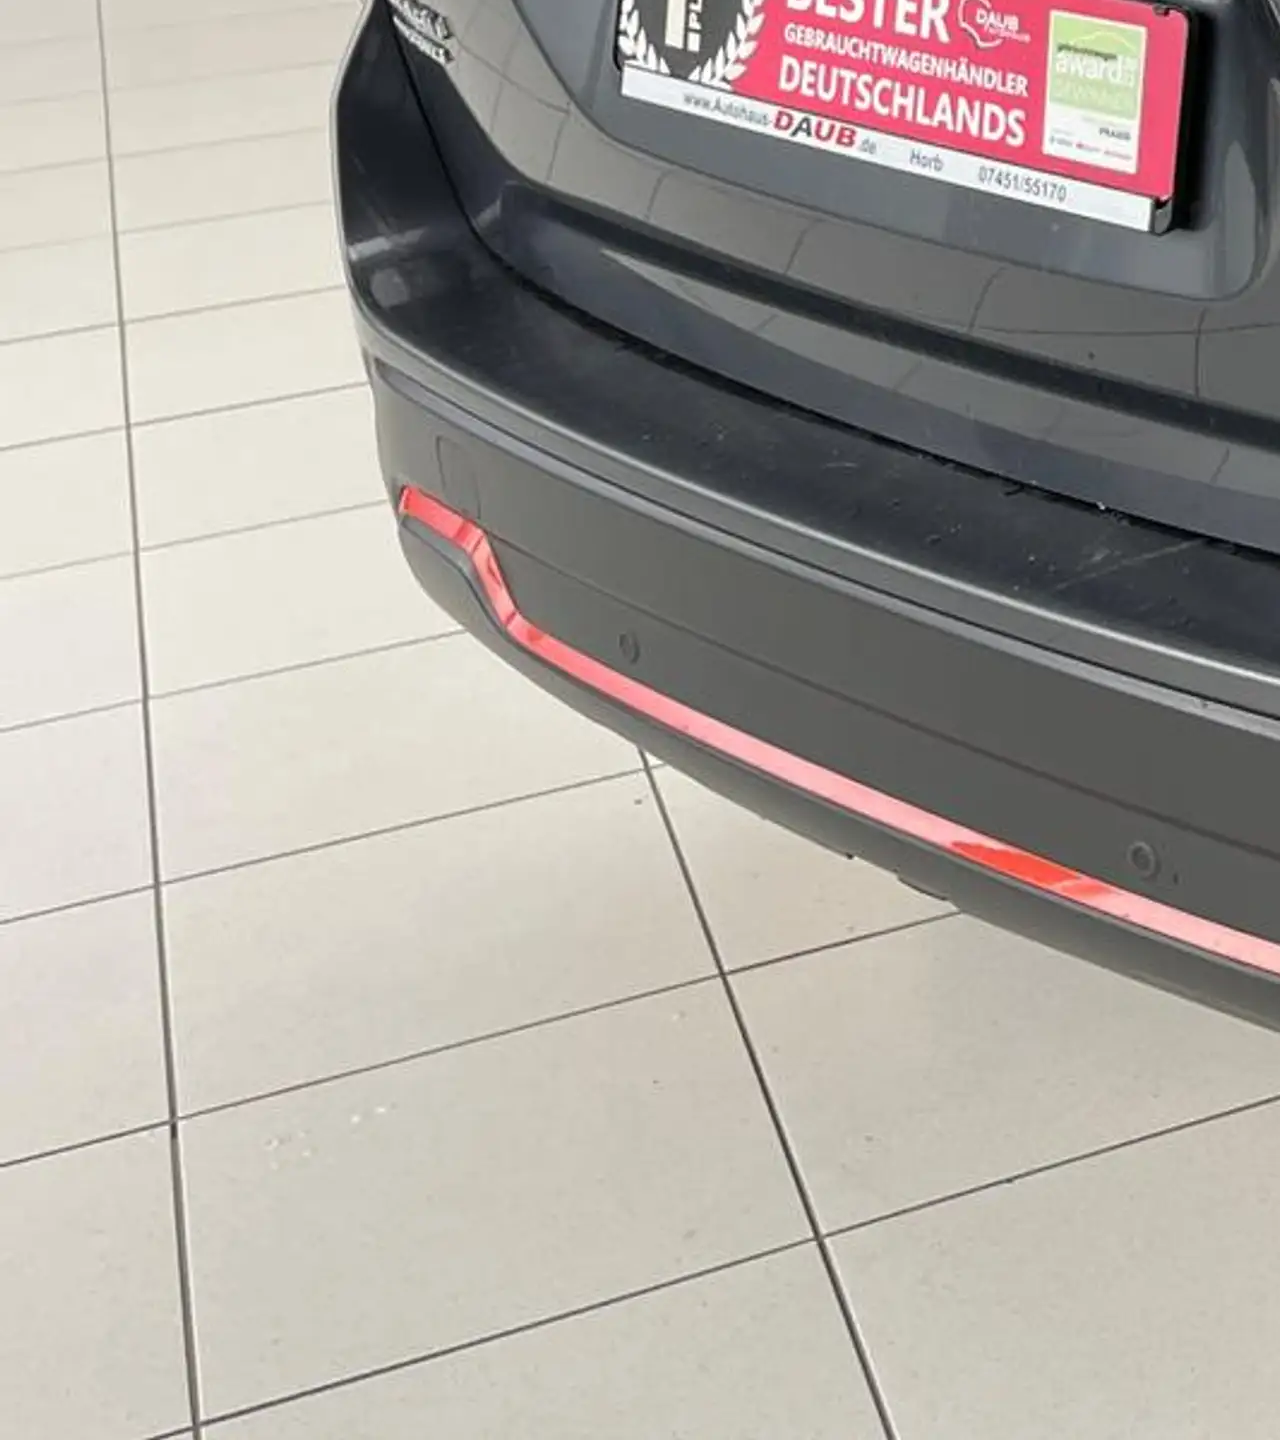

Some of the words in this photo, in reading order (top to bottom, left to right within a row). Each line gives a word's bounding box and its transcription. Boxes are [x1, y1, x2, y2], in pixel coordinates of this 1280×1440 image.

[784, 22, 1029, 98] GEBRAUCHTWAGENHÄNDLER
[778, 54, 1027, 148] DEUTSCHLANDS
[909, 148, 944, 173] Horb
